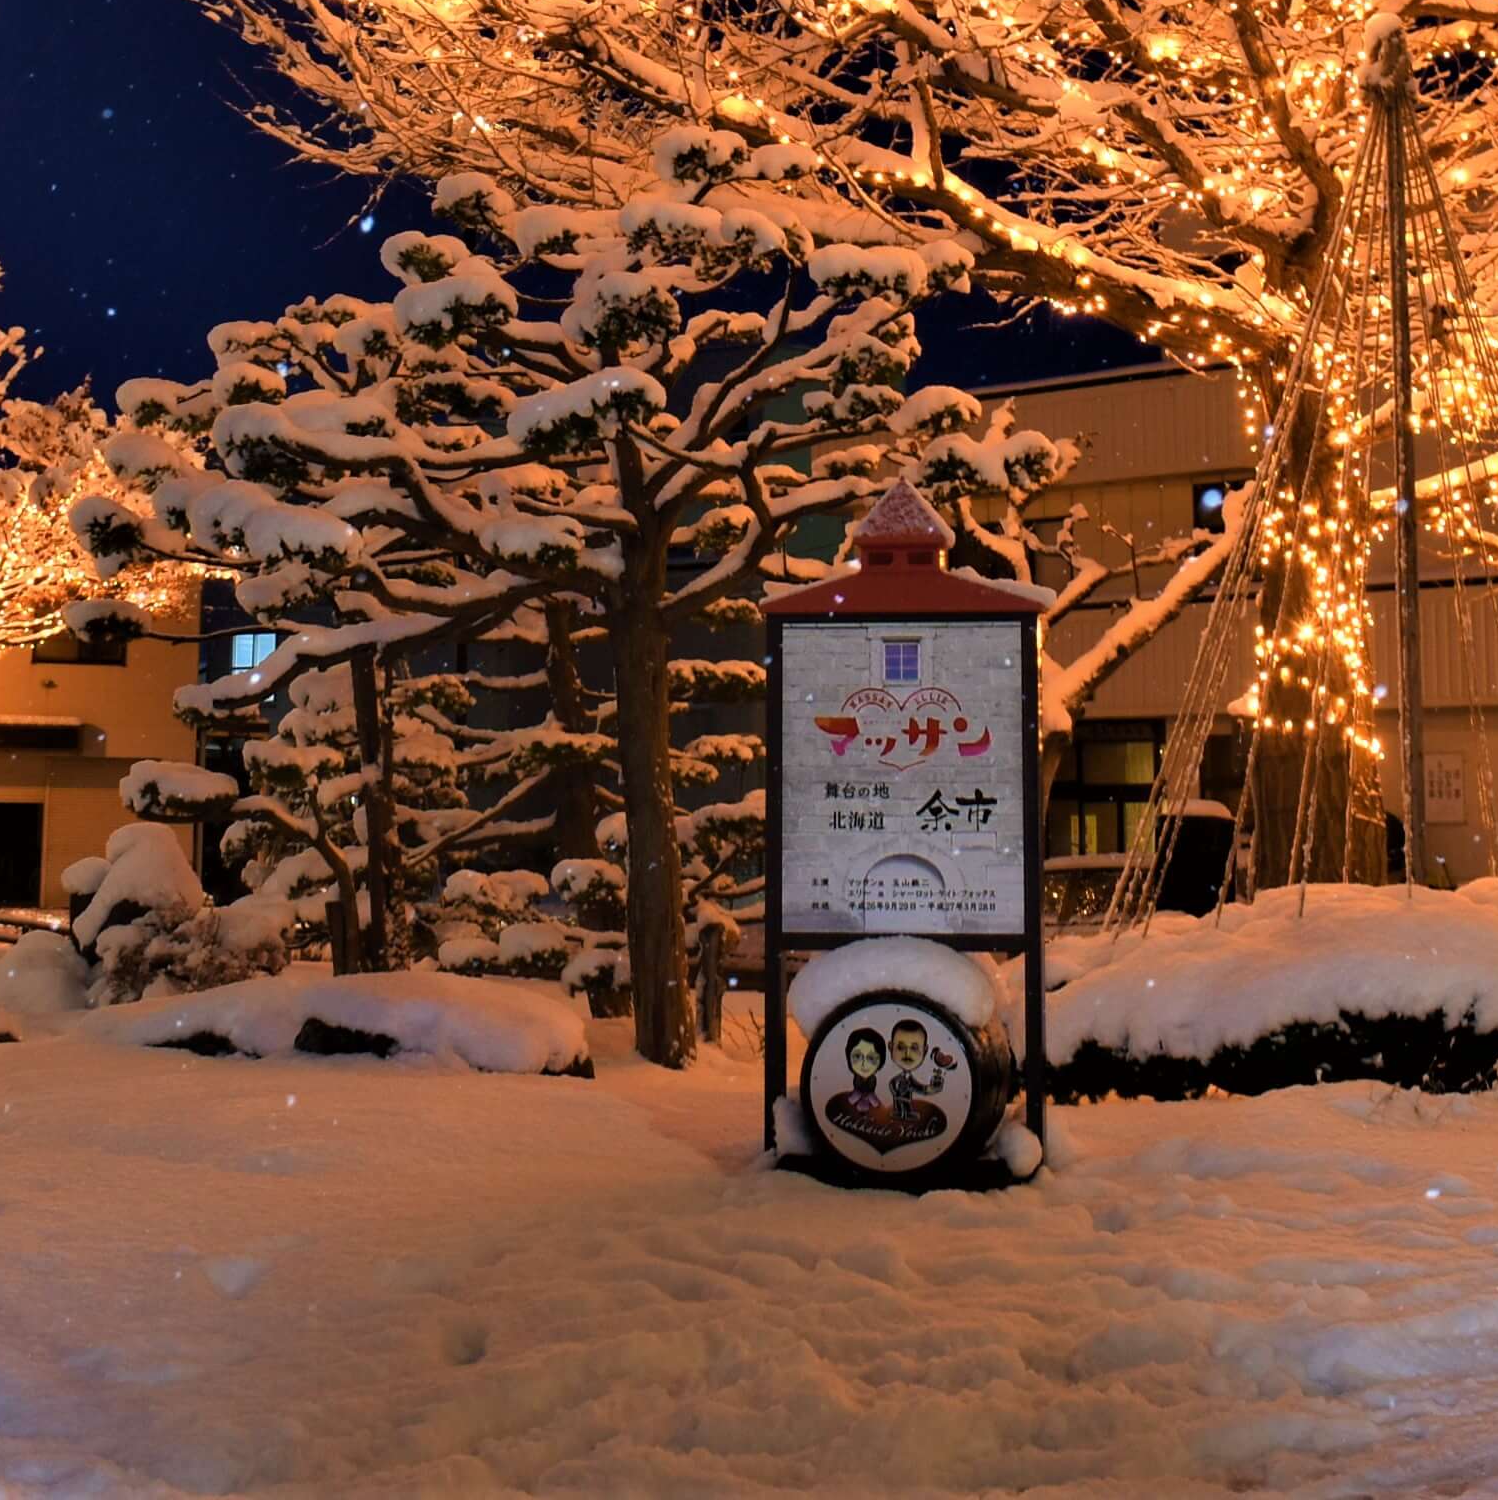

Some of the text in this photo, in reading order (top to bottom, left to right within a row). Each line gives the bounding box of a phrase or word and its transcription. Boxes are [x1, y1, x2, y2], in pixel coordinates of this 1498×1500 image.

[814, 716, 992, 757] マッサン
[825, 782, 890, 799] 舞台の地
[829, 811, 885, 830] 北海道
[916, 788, 997, 832] 余市
